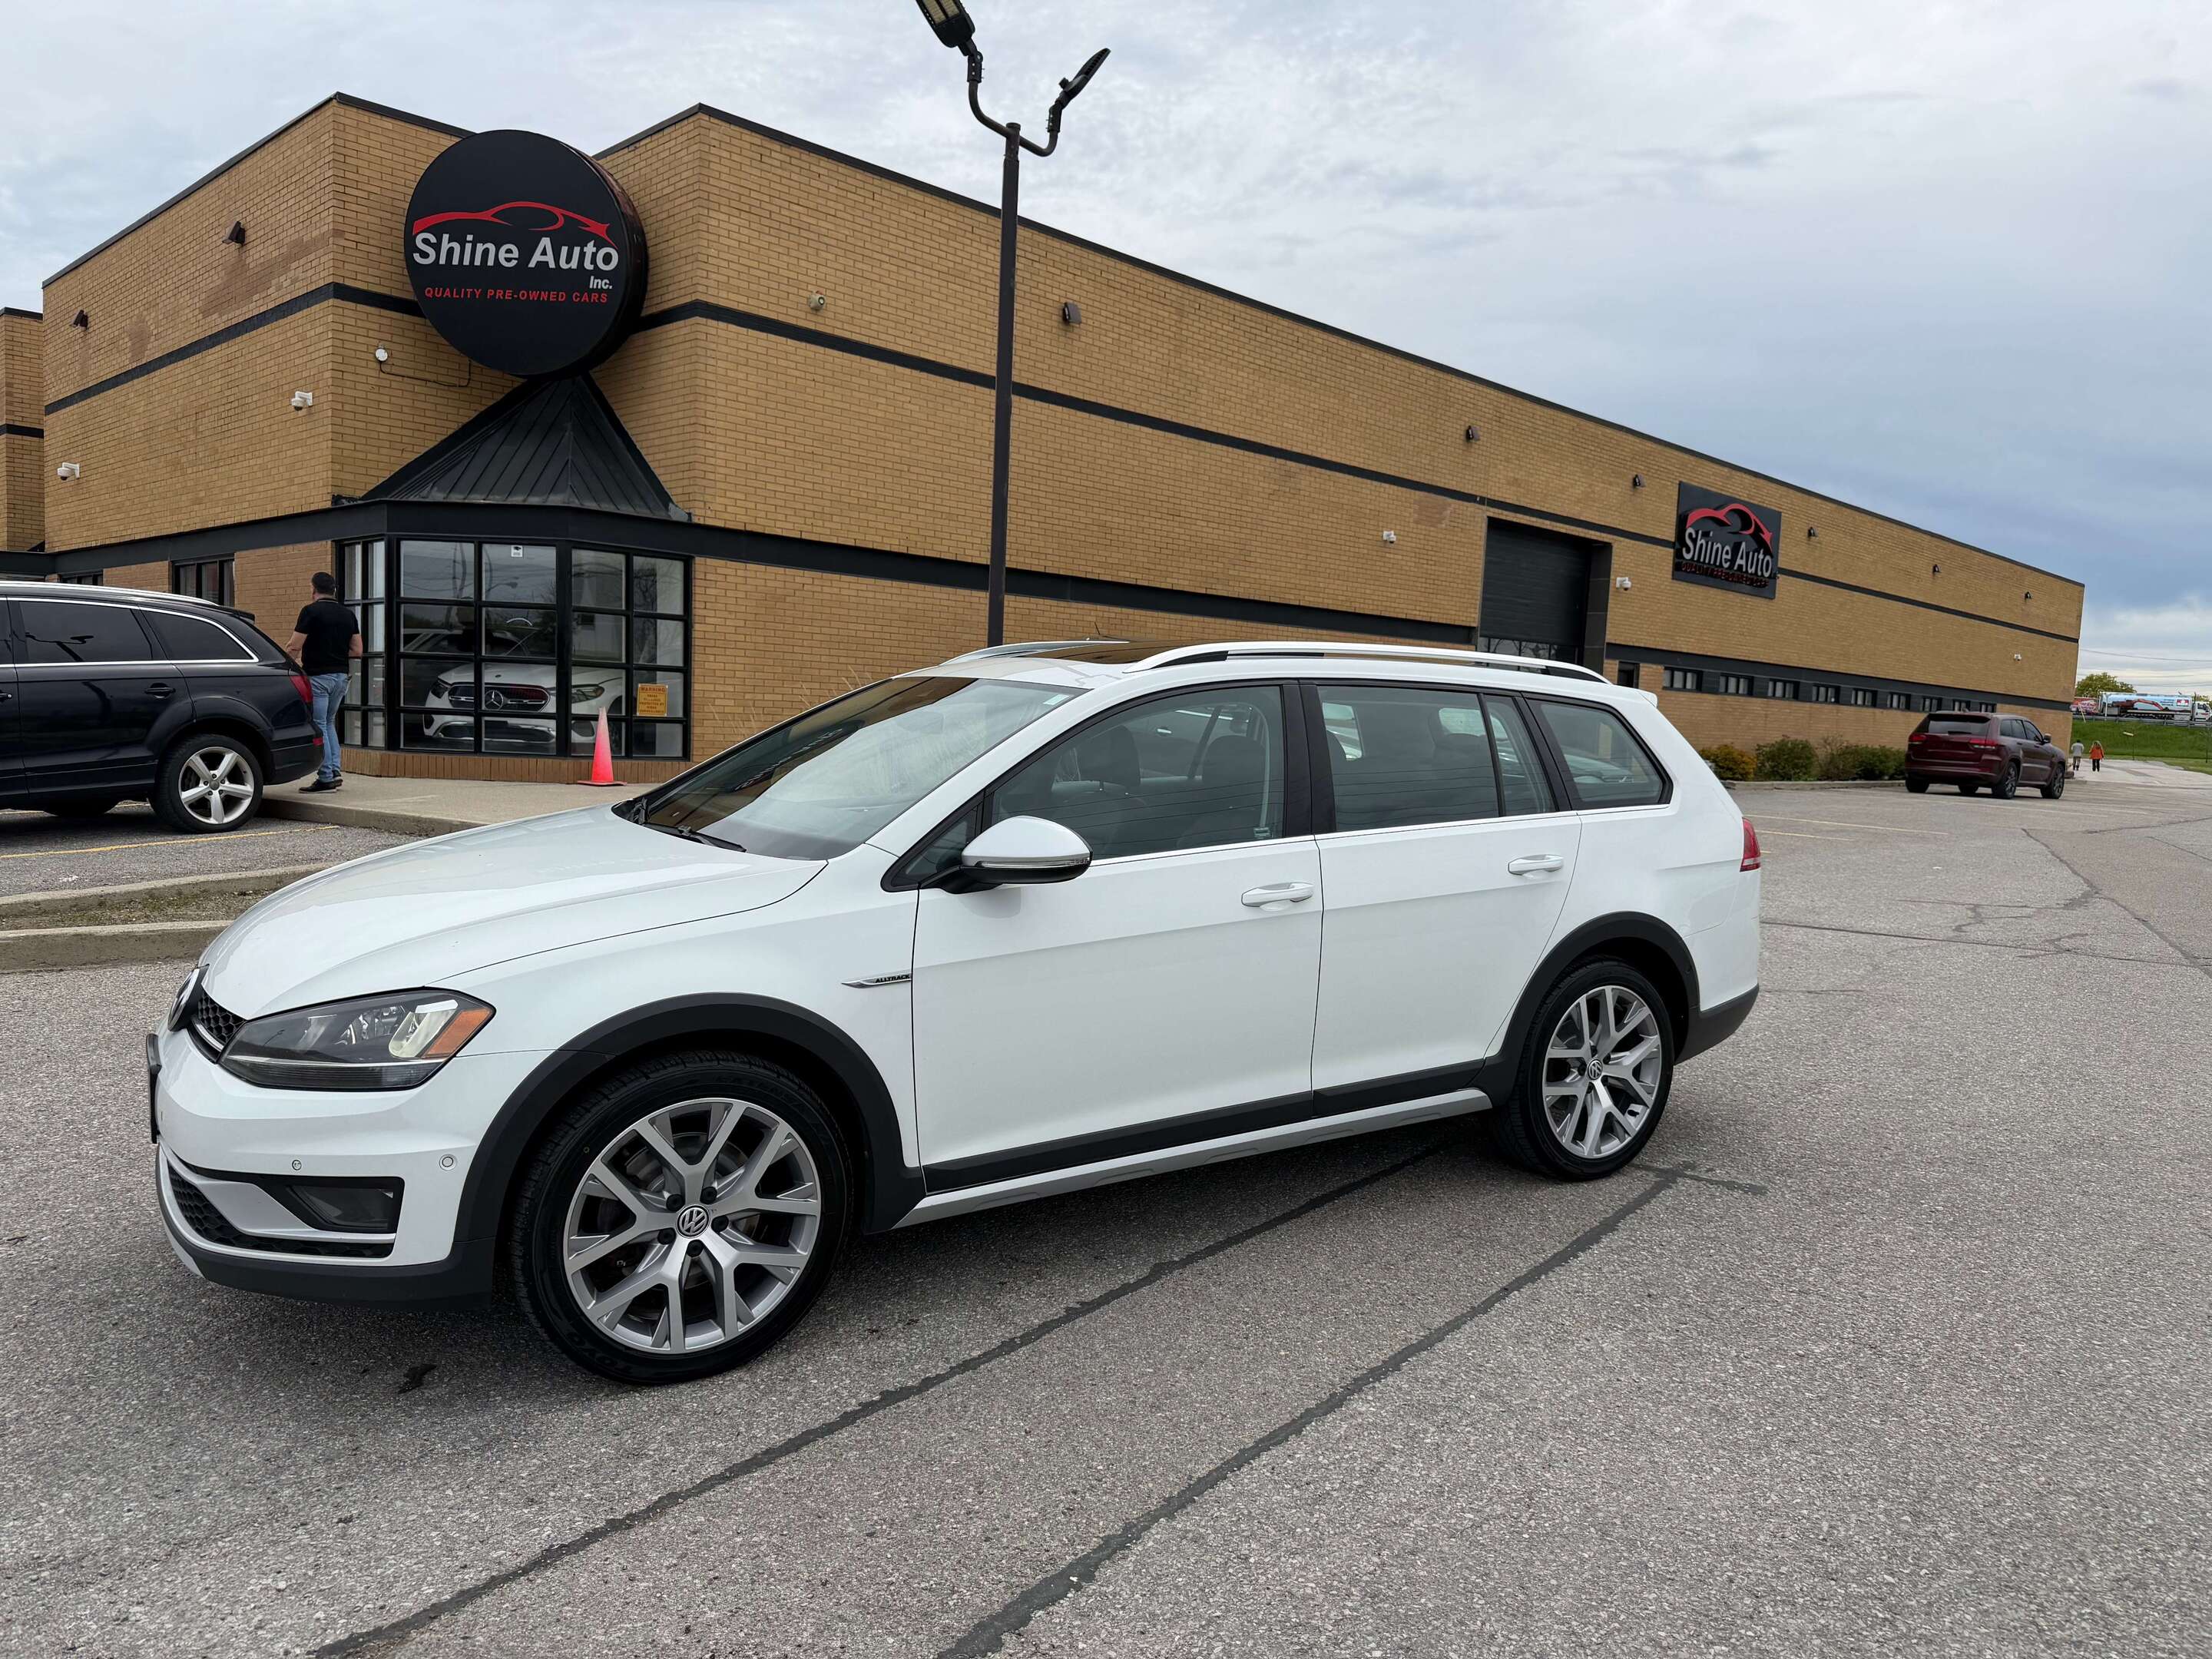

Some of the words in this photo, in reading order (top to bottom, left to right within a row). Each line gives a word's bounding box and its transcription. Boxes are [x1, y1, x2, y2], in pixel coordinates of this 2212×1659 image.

[412, 233, 519, 267] Shine
[528, 237, 619, 271] Auto
[589, 276, 613, 290] Inc.
[425, 287, 481, 300] QUALITY
[487, 290, 566, 302] PRE-OWNED
[572, 292, 608, 303] CARS
[1682, 528, 1731, 568] Shine
[1734, 541, 1772, 578] Auto
[876, 974, 910, 983] ALLTRACK
